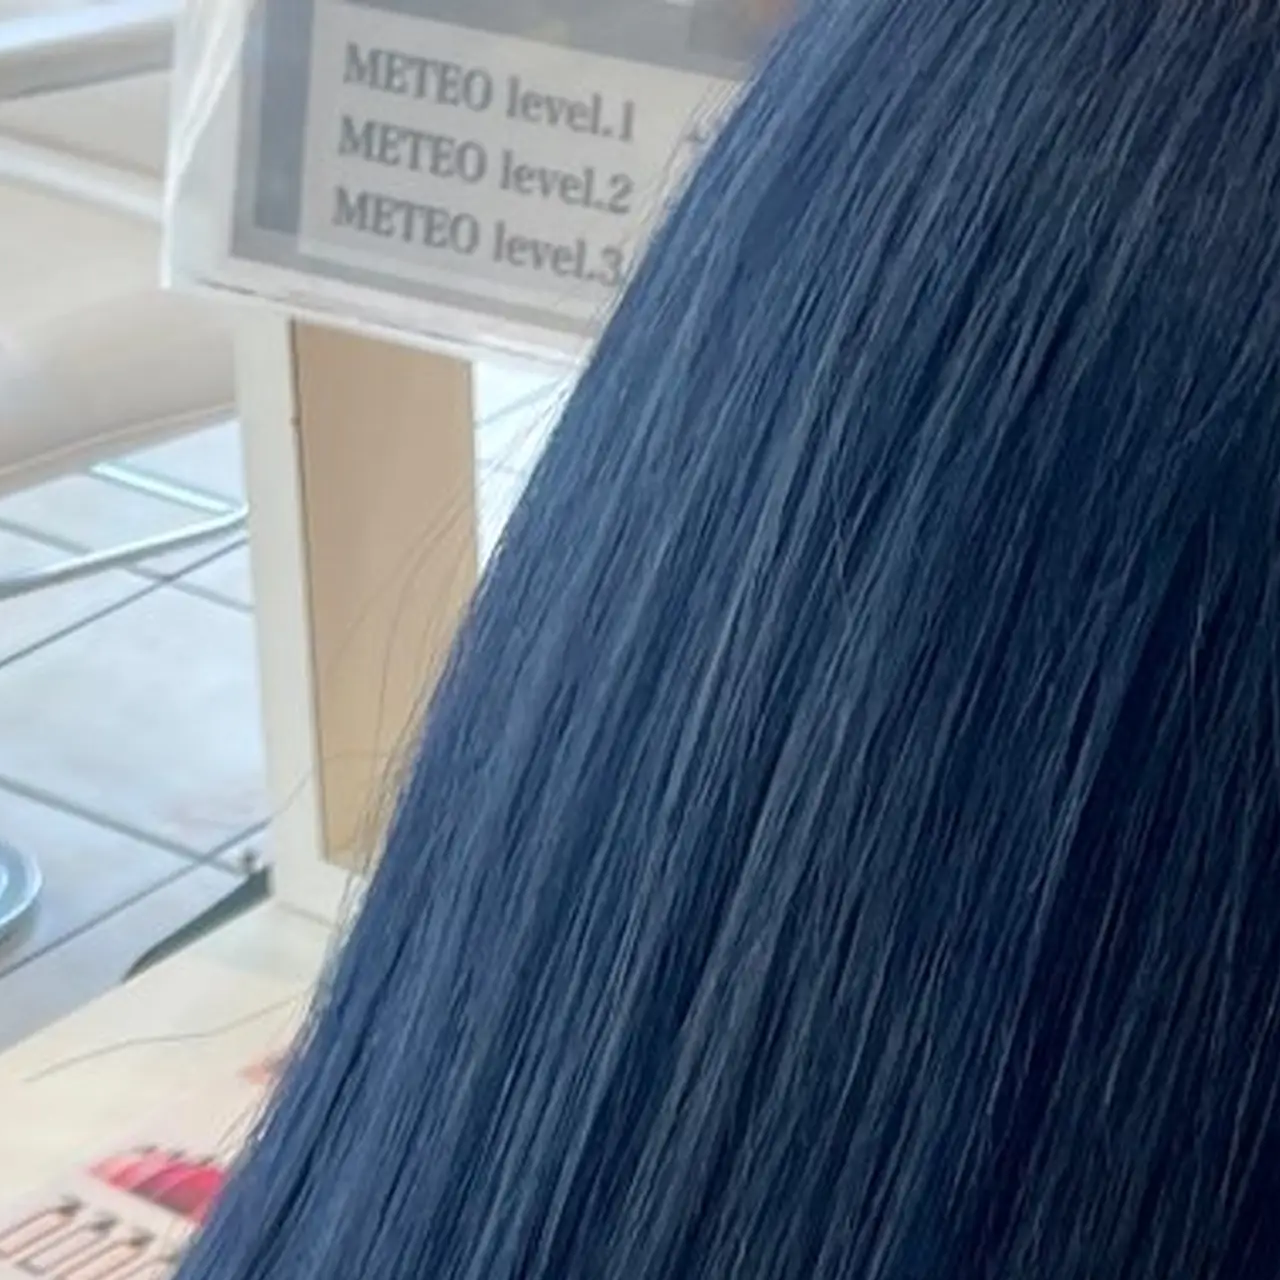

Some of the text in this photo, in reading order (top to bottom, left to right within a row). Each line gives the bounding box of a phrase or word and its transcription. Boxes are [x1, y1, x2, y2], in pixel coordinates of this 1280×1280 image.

[342, 40, 636, 142] METEO level.1
[337, 113, 634, 215] METEO level.2
[331, 184, 624, 288] METEO level.3
